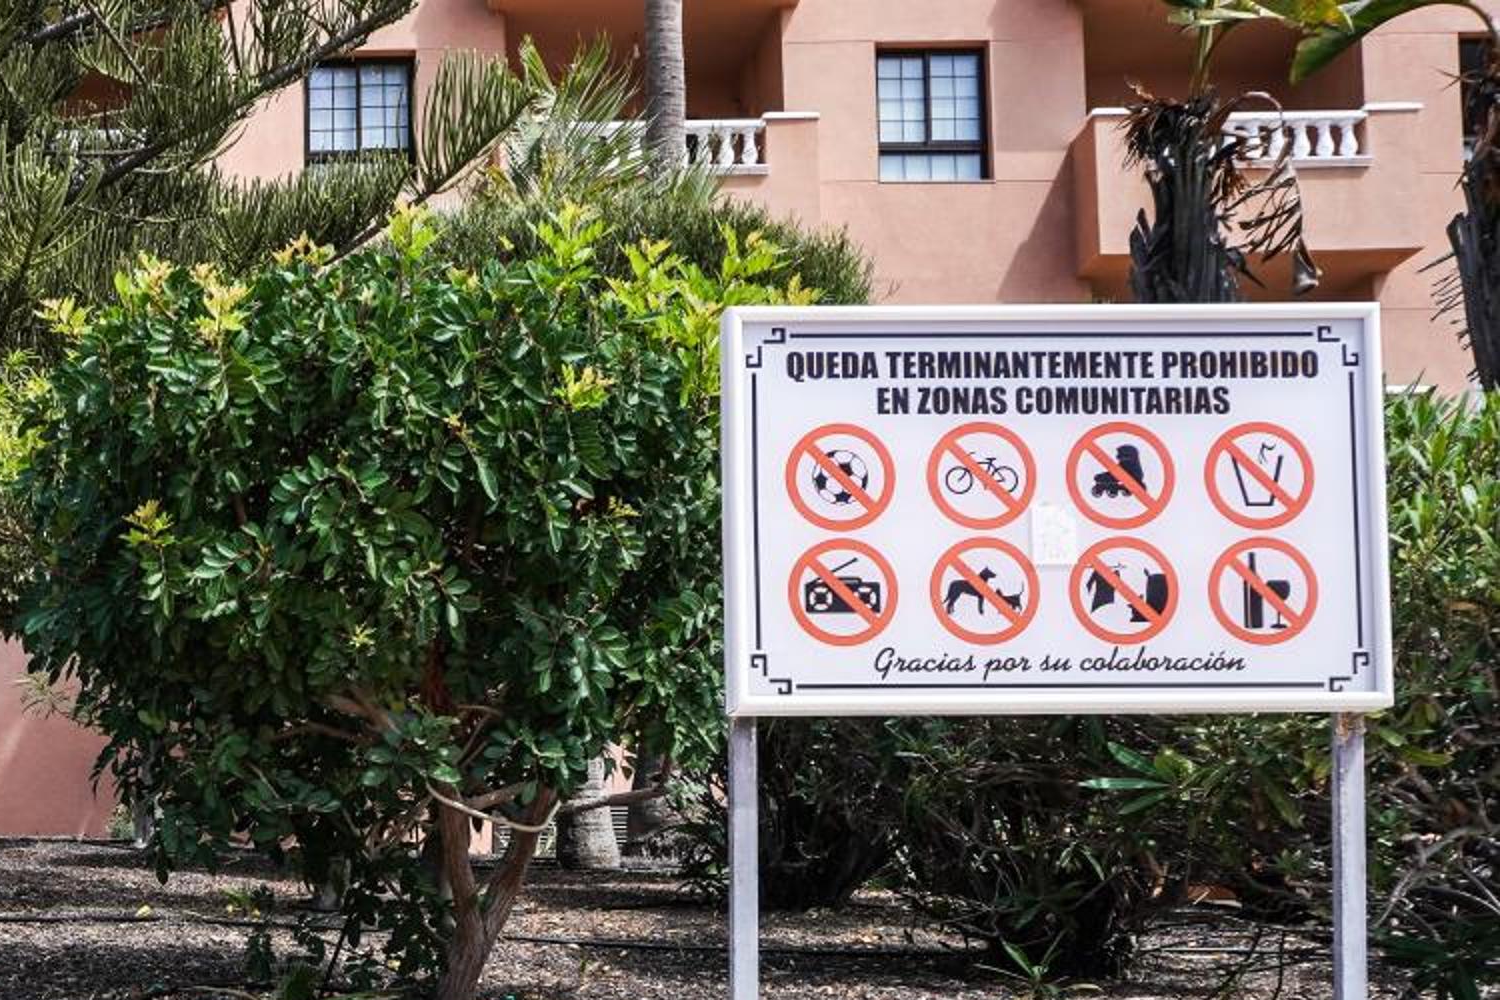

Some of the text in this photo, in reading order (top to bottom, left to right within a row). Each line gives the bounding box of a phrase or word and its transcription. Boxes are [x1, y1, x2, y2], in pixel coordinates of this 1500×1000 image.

[786, 349, 1318, 382] QUEDA TERMINANTEMENTE PROHIBIDO
[876, 385, 1230, 415] EN ZONAS COMUNITARIAS
[874, 646, 1246, 681] Gracias por su colaboración
